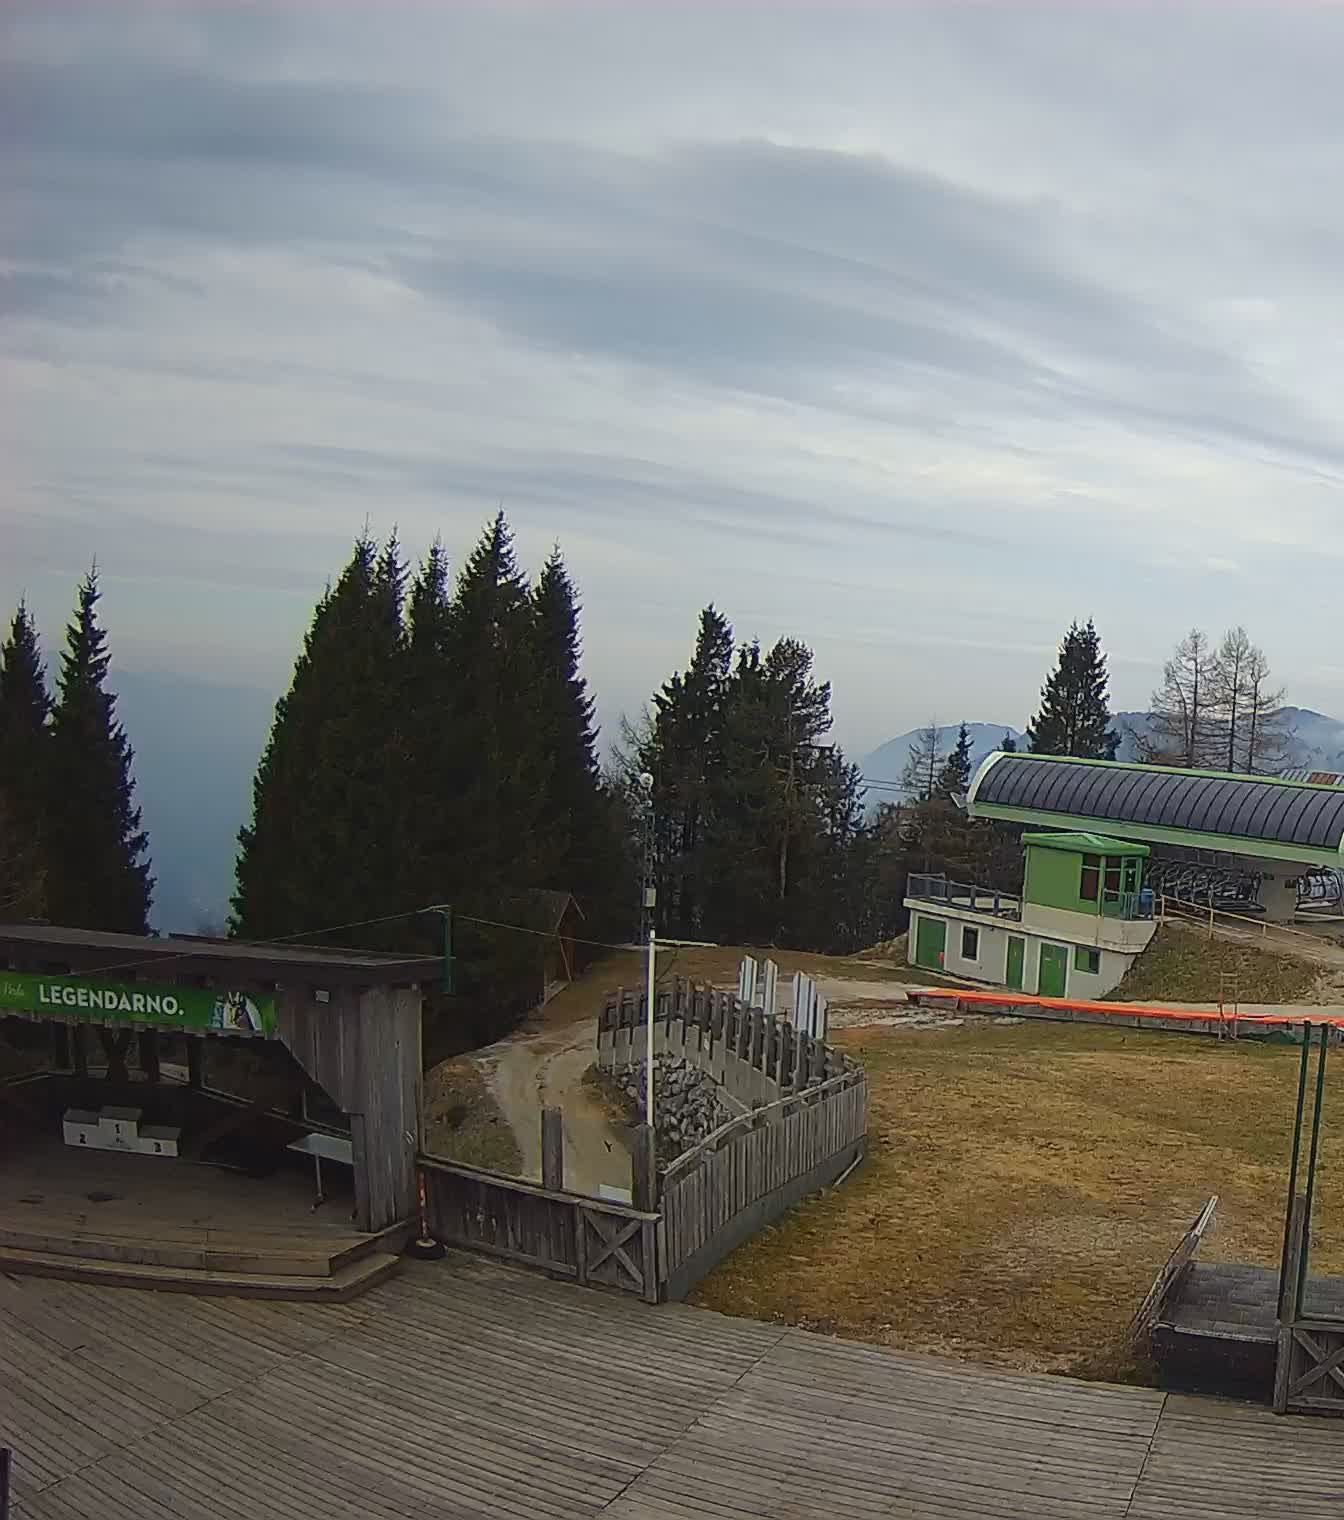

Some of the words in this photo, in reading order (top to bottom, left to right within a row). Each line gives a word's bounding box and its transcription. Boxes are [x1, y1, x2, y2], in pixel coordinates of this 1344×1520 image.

[39, 984, 185, 1016] LEGENDARNO.
[114, 1123, 121, 1134] 1
[79, 1133, 87, 1144] 2
[154, 1142, 162, 1153] 3
